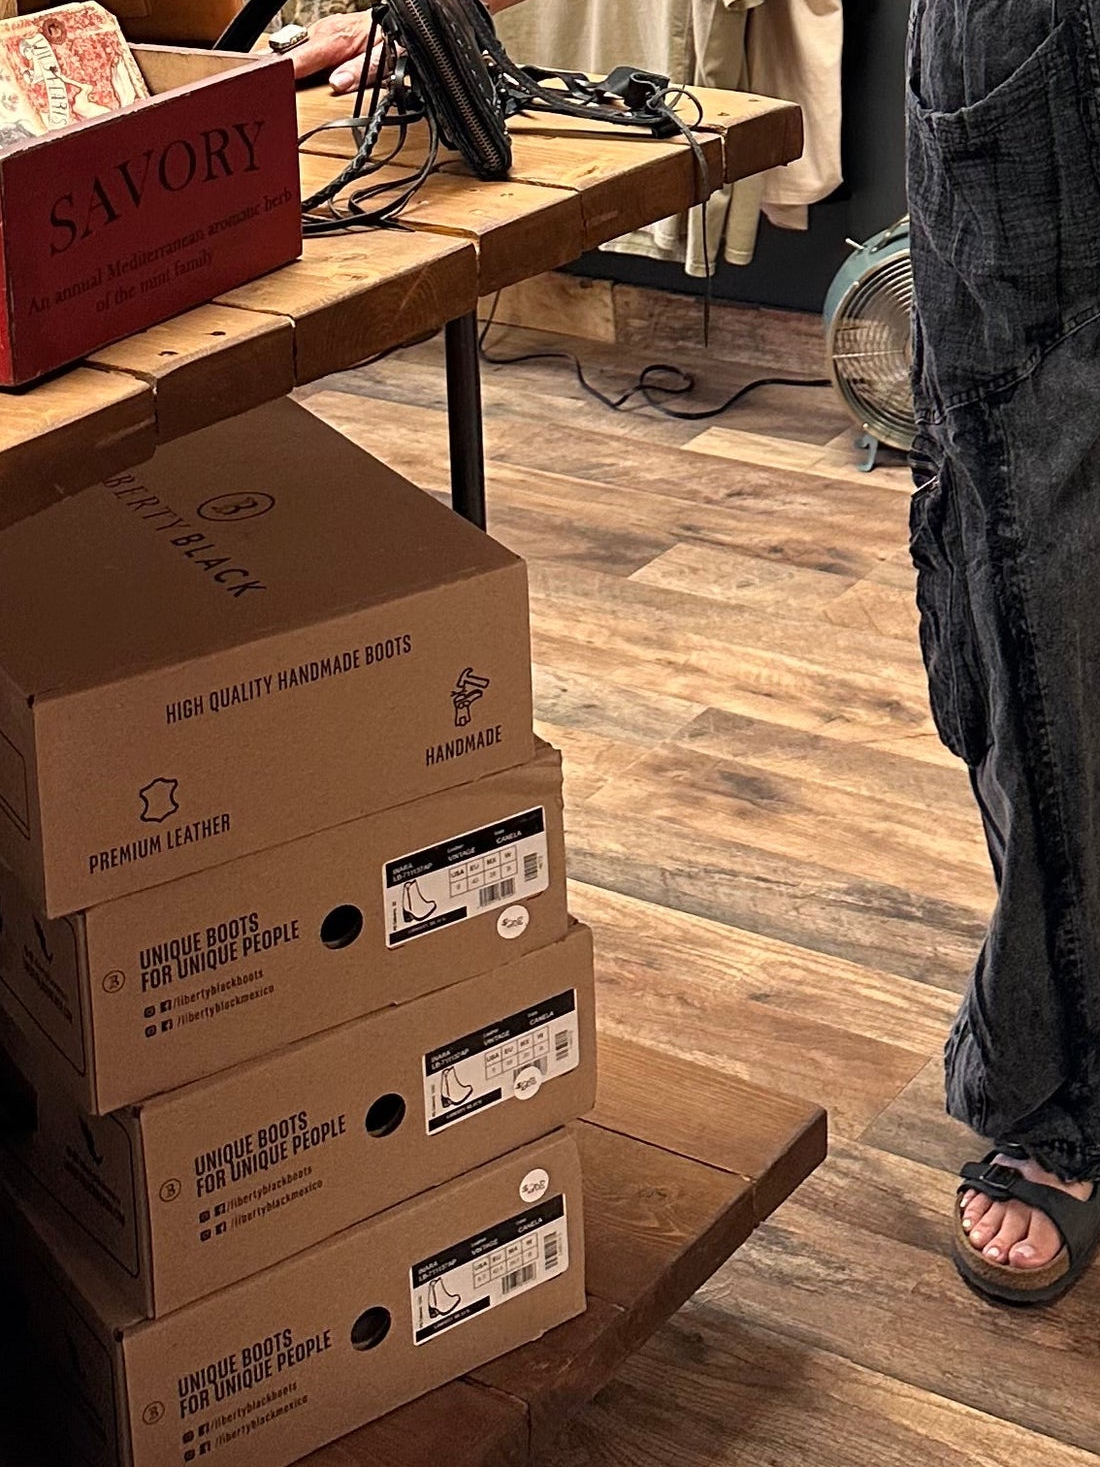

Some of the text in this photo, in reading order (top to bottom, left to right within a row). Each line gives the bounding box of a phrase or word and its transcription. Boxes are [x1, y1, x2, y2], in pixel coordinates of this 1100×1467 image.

[49, 121, 266, 258] SAVORY
[28, 187, 292, 316] An annual Mediterranean aromatic herb
[95, 247, 215, 314] of the mint family
[103, 474, 267, 598] BERTY BLACK
[166, 634, 412, 724] HIGH QUALITY HANDMADE BOOTS
[425, 724, 503, 767] HANDMADE
[89, 813, 231, 875] PREMIUM LEATHER
[140, 912, 259, 970] UNIQUE BOOTS
[141, 919, 299, 993] FOR UNIQUE PEOPLE
[194, 1111, 308, 1176] UNIQUE BOOTS
[197, 1114, 346, 1198] FOR UNIQUE PEOPLE
[178, 1328, 292, 1398] UNIQUE BOOTS
[180, 1330, 331, 1419] FOR UNIQUE PEOPLE
